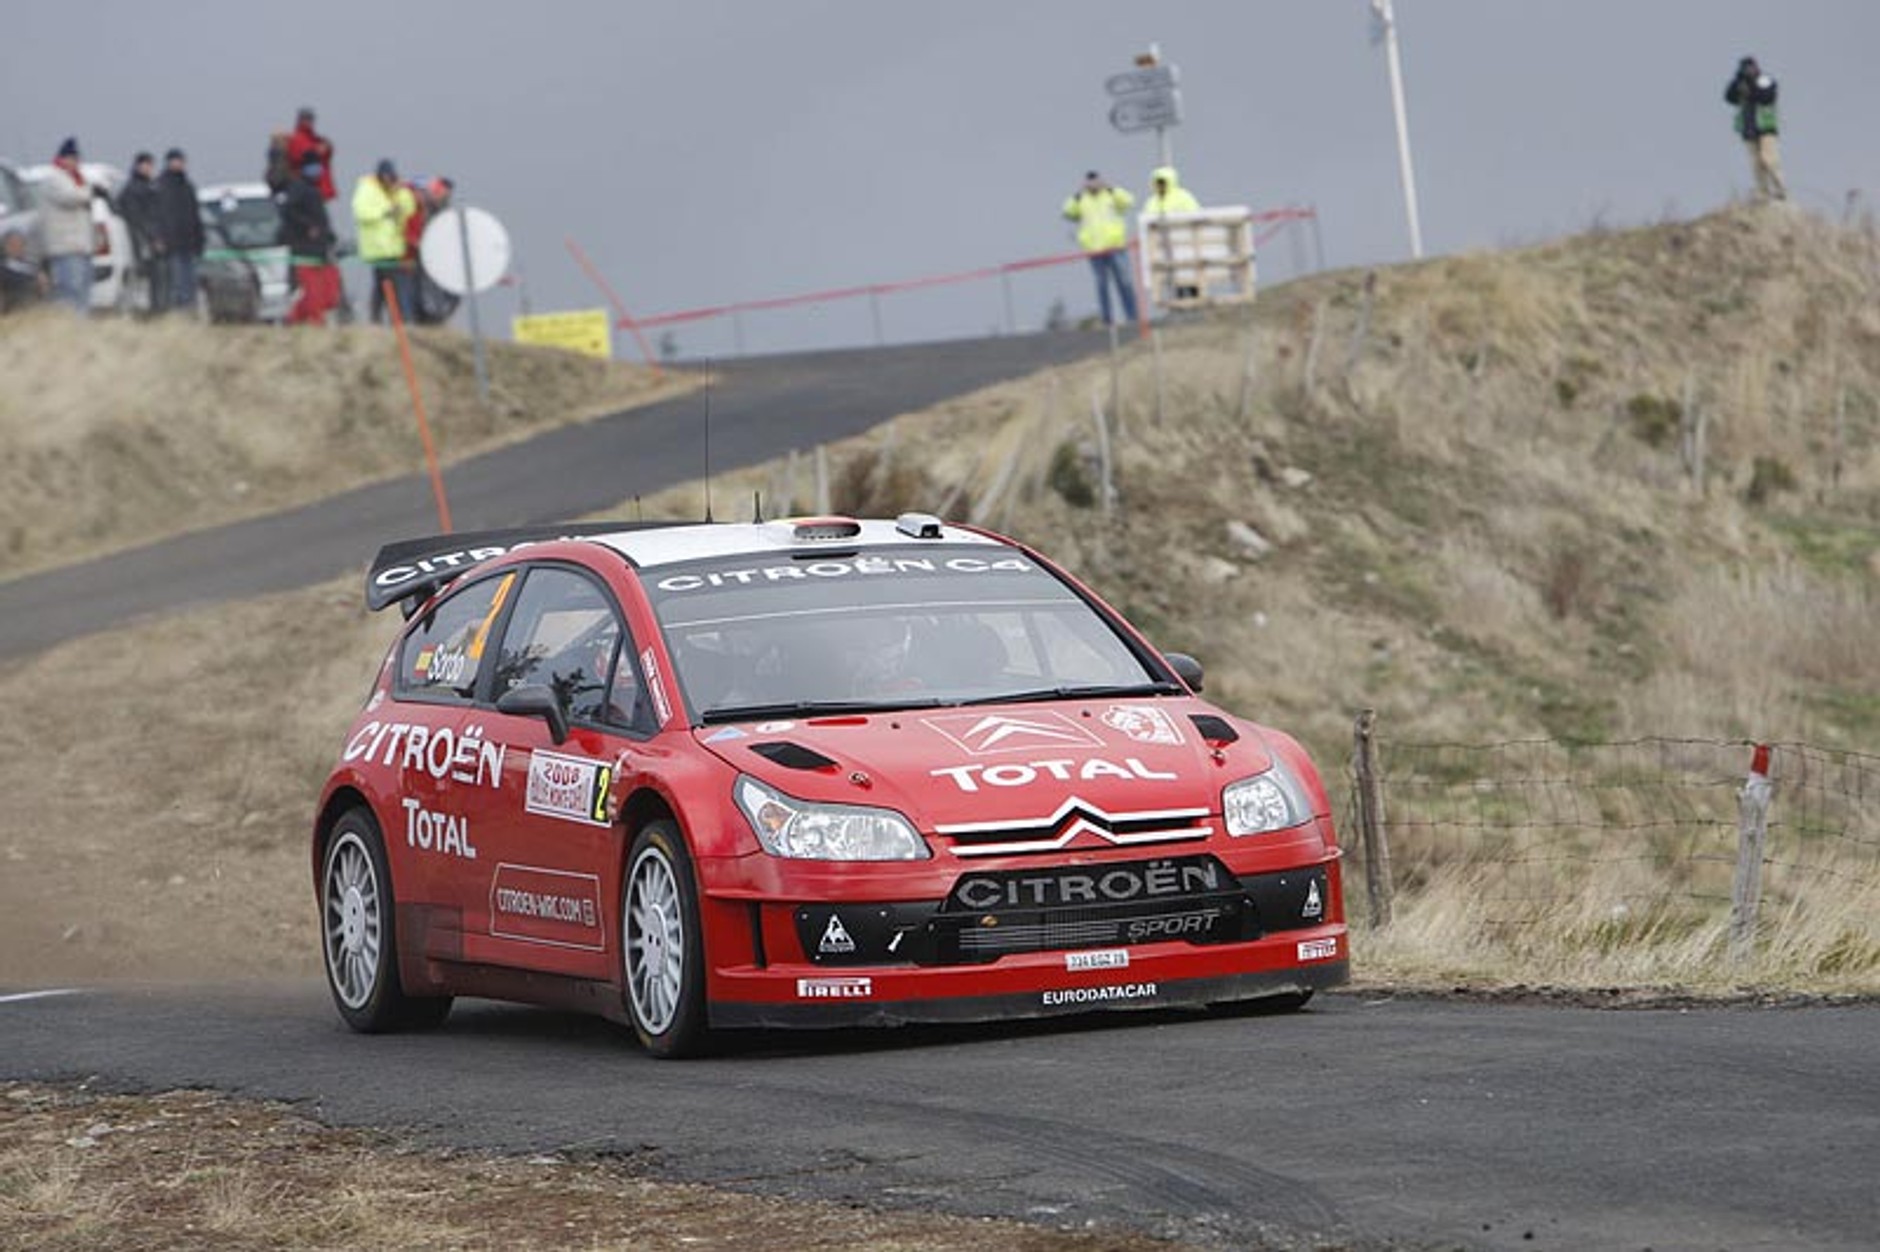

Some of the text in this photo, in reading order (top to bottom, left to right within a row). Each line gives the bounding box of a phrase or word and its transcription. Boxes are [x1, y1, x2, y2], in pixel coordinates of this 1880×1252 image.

[375, 536, 583, 586] CITR
[656, 556, 1032, 591] CITROËN C4
[342, 720, 507, 789] CITROËN
[930, 757, 1179, 792] TOTAL
[594, 767, 610, 821] 2
[957, 861, 1218, 908] CITROËN
[1128, 913, 1219, 937] SPORT
[797, 978, 872, 997] PIRELLI
[1042, 982, 1158, 1005] EURODATACAR
